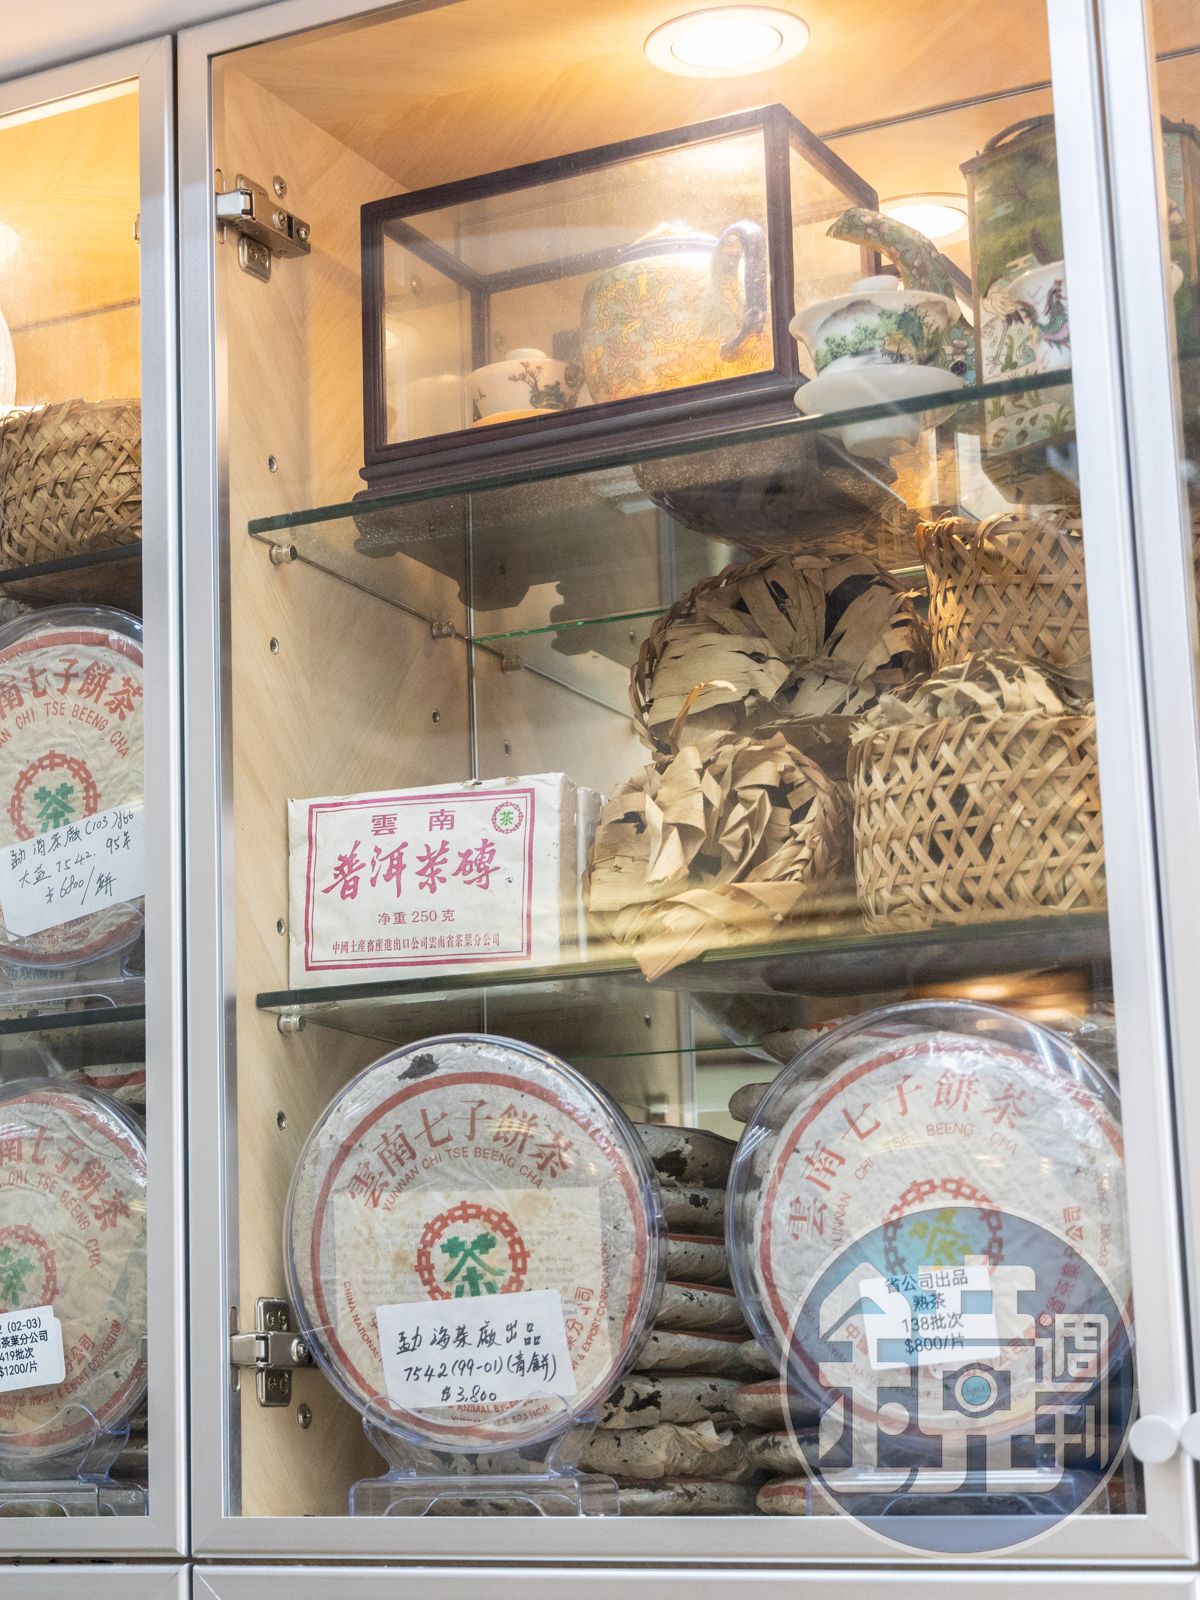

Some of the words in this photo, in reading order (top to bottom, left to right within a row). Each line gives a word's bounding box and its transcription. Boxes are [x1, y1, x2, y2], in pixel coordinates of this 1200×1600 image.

[16, 709, 37, 730] CHI
[44, 700, 66, 717] TSE
[71, 704, 108, 732] BEENG
[110, 730, 130, 759] CHA
[371, 808, 456, 837] 雲南
[321, 838, 501, 901] 普洱茶磚
[377, 911, 406, 926] 净重
[412, 910, 438, 924] 250
[441, 908, 456, 923] 克
[926, 1122, 974, 1137] BEENG
[348, 1098, 582, 1211] 雲南七子餅茶
[789, 1066, 1030, 1243] 雲南七子餅茶
[382, 1162, 421, 1213] YUNNAN
[421, 1152, 443, 1170] CHI
[446, 1145, 470, 1160] TSE
[473, 1146, 517, 1168] BEENG
[519, 1163, 544, 1189] CHA
[37, 1173, 58, 1192] TSE
[60, 1189, 89, 1231] BEENG
[85, 1237, 103, 1270] CHA
[343, 1280, 356, 1313] CHINA
[884, 1269, 969, 1294] 省公司出品
[901, 1312, 965, 1333] 138批次
[0, 1347, 35, 1362] 419批次
[903, 1333, 965, 1356] $800/片
